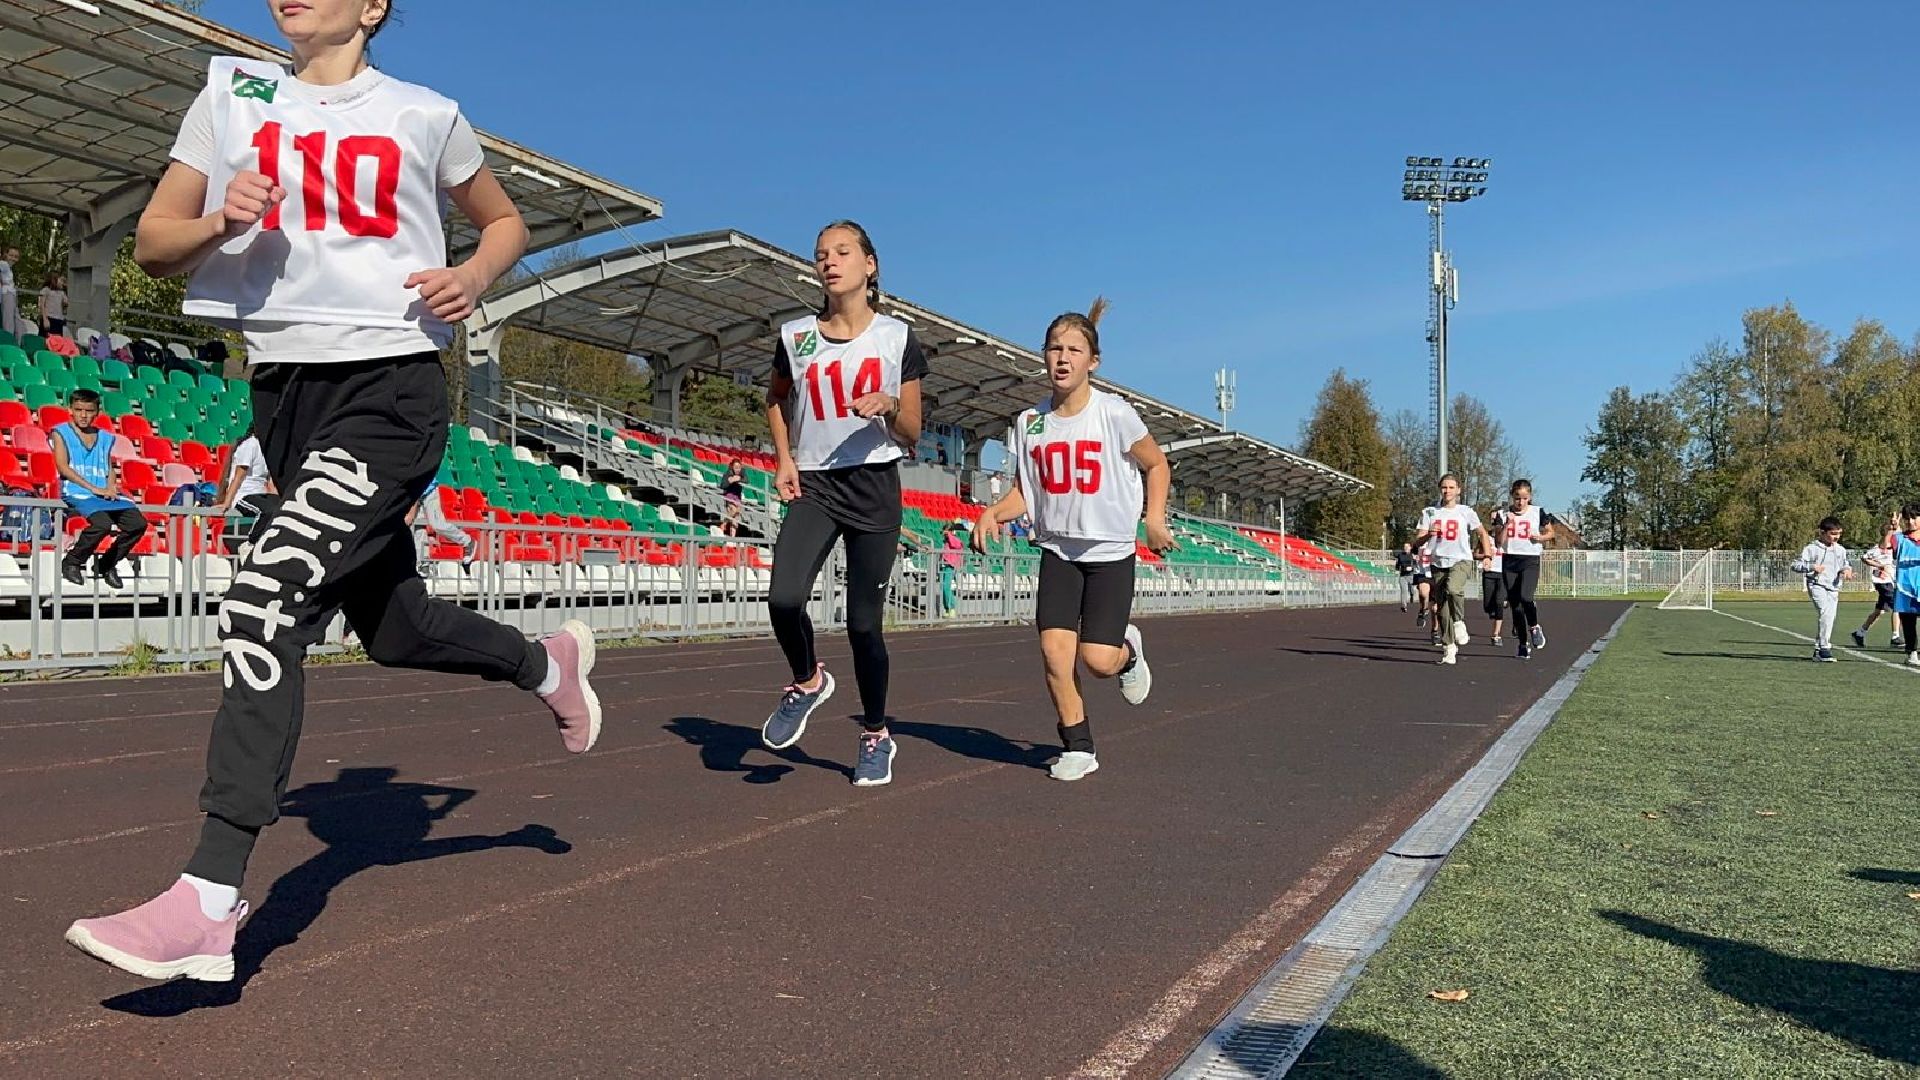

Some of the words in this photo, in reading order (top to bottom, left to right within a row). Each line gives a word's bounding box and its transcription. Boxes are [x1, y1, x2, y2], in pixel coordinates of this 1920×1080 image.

[251, 121, 402, 239] 110
[805, 357, 882, 421] 114
[1030, 440, 1102, 494] 105
